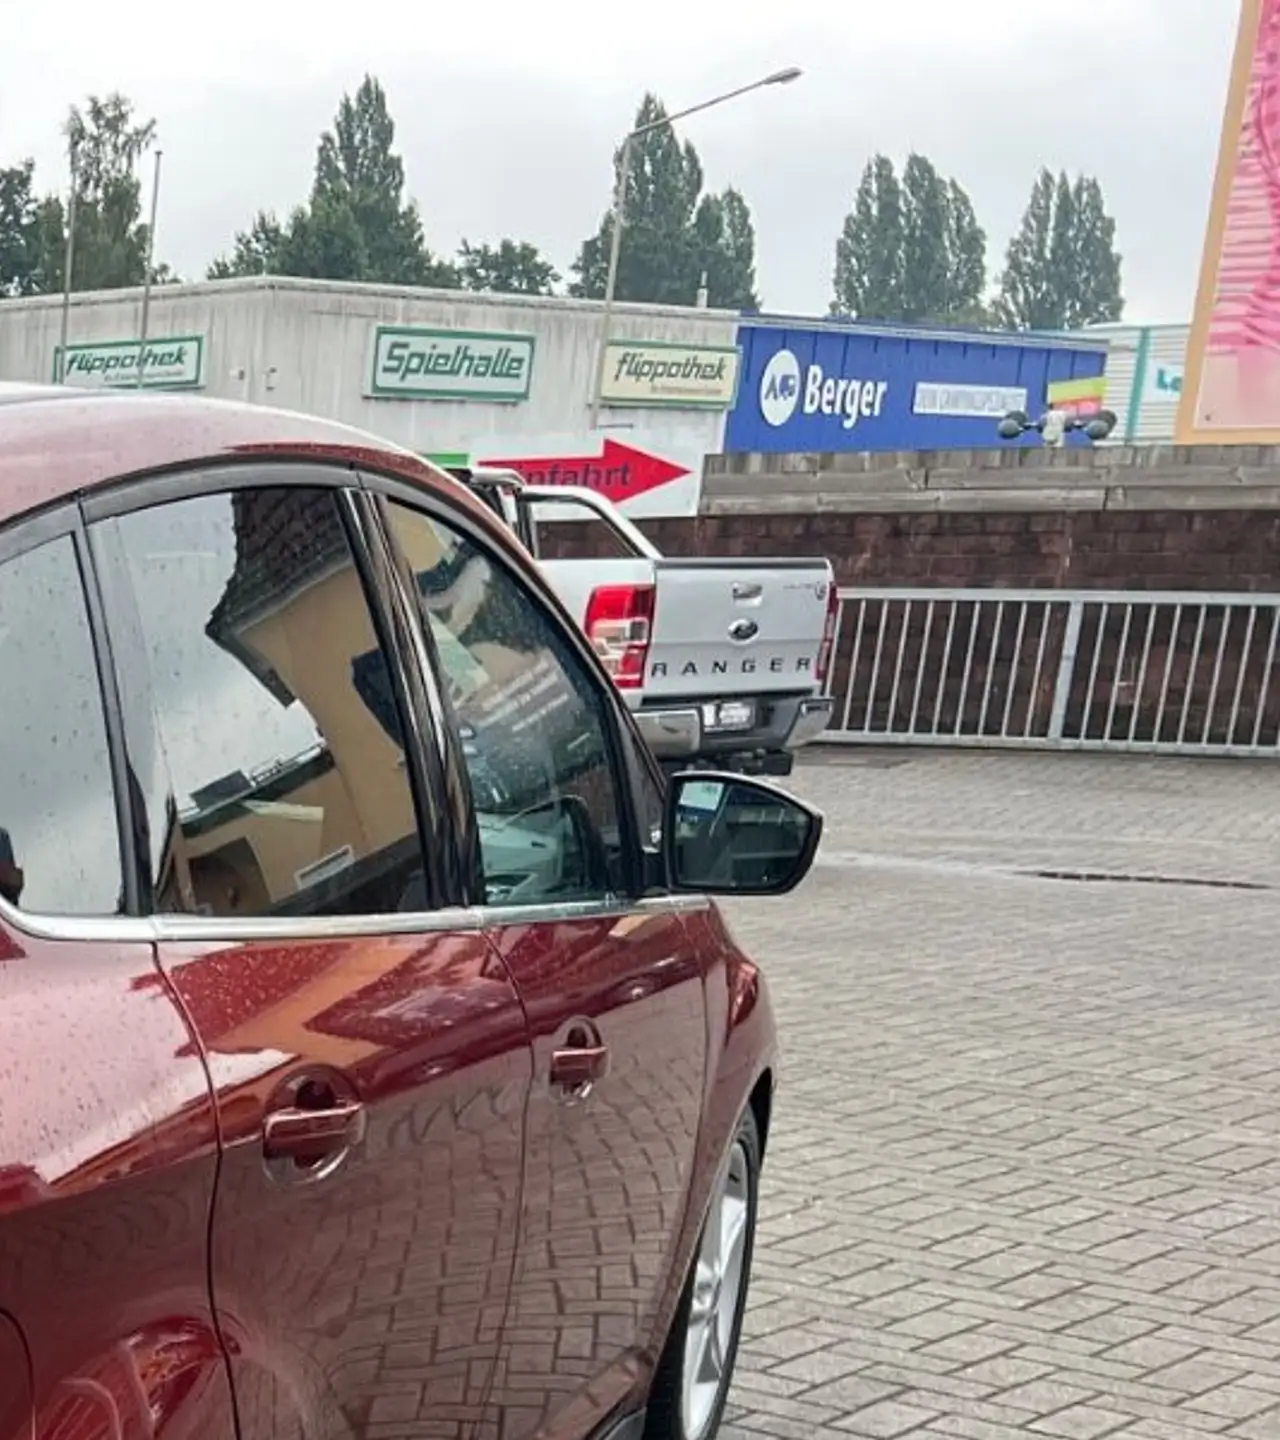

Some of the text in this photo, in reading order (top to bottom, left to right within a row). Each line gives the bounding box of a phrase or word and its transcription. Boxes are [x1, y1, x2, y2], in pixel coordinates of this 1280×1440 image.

[382, 342, 525, 382] Spielhalle
[614, 351, 726, 382] flippothek
[803, 365, 888, 429] Berger
[519, 462, 632, 488] nfahrt
[651, 656, 811, 678] RANGER
